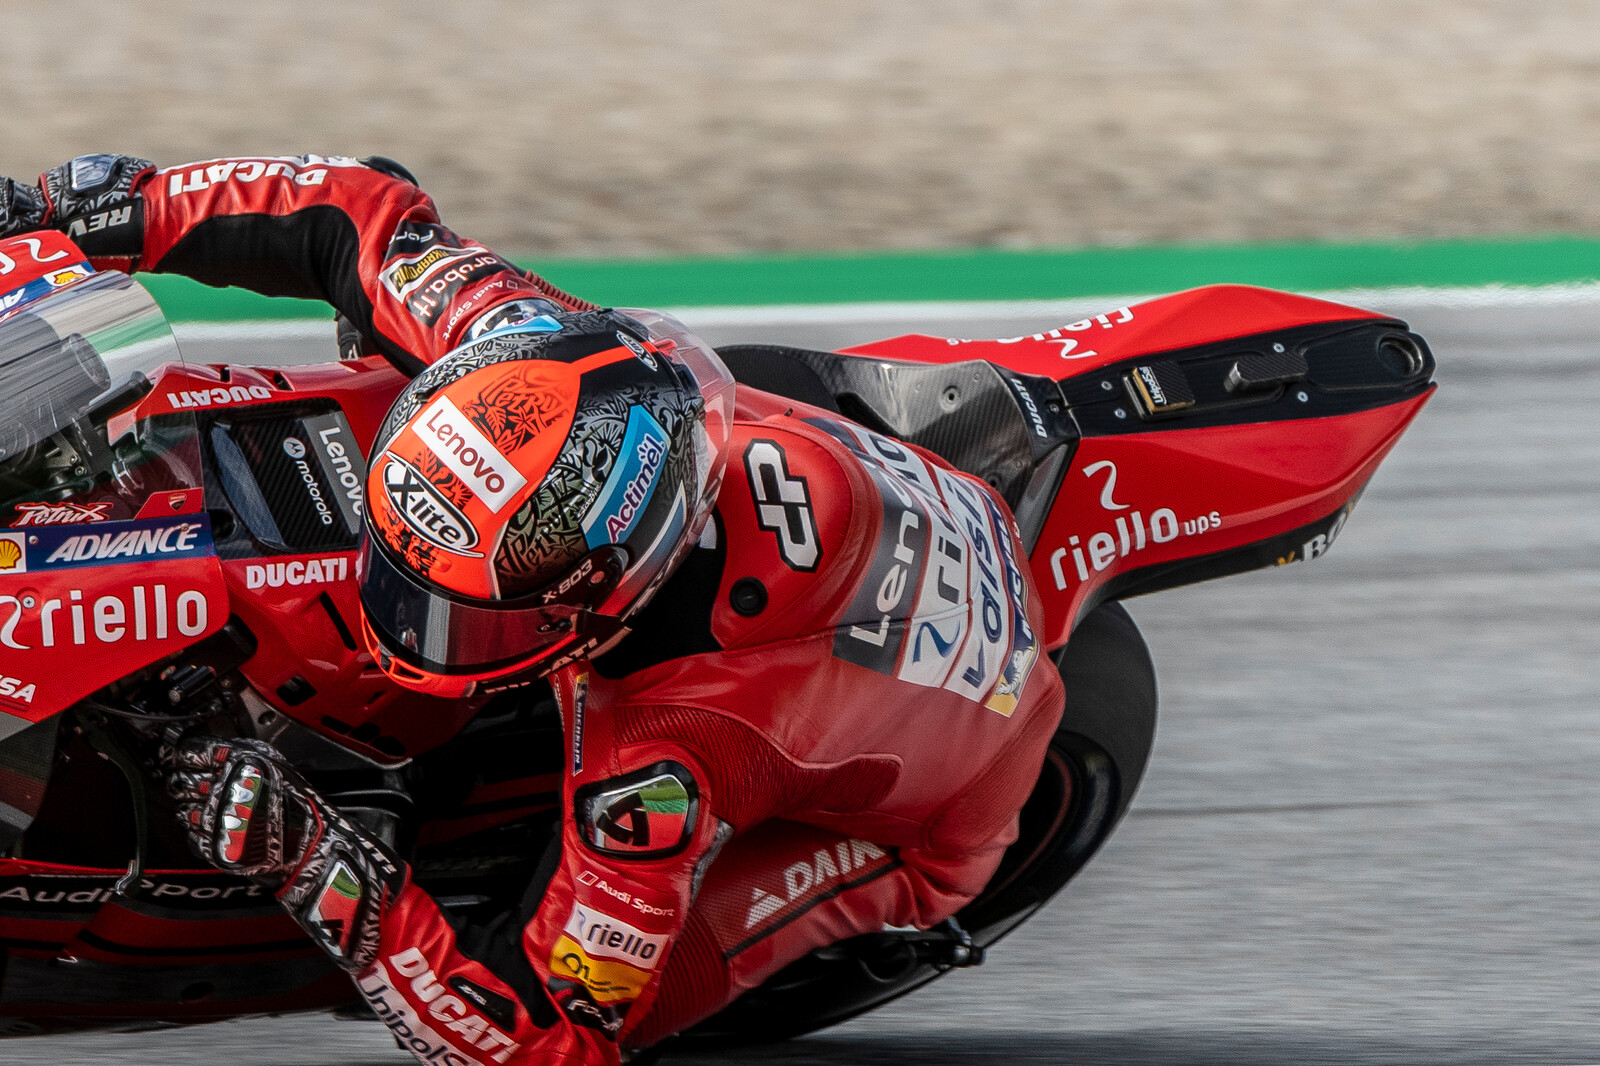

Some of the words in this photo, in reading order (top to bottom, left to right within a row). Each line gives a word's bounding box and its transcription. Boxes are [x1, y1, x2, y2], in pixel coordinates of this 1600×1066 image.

[169, 161, 328, 197] DUCATI
[412, 256, 498, 319] aruba.it
[473, 281, 503, 300] Audi
[443, 301, 472, 341] Sport
[167, 386, 272, 409] DUCATI
[1011, 378, 1047, 438] DUCATI
[426, 408, 505, 494] Lenovo
[296, 460, 333, 525] motorola
[386, 466, 462, 544] X-lite
[46, 523, 203, 563] ADVANCE
[246, 557, 348, 589] DUCATI
[1050, 507, 1179, 591] riello
[1184, 510, 1222, 537] ups
[40, 584, 208, 647] riello
[574, 701, 583, 764] MICHELIN
[595, 879, 632, 904] Audi
[586, 922, 658, 960] riello
[388, 946, 522, 1065] DUCATI
